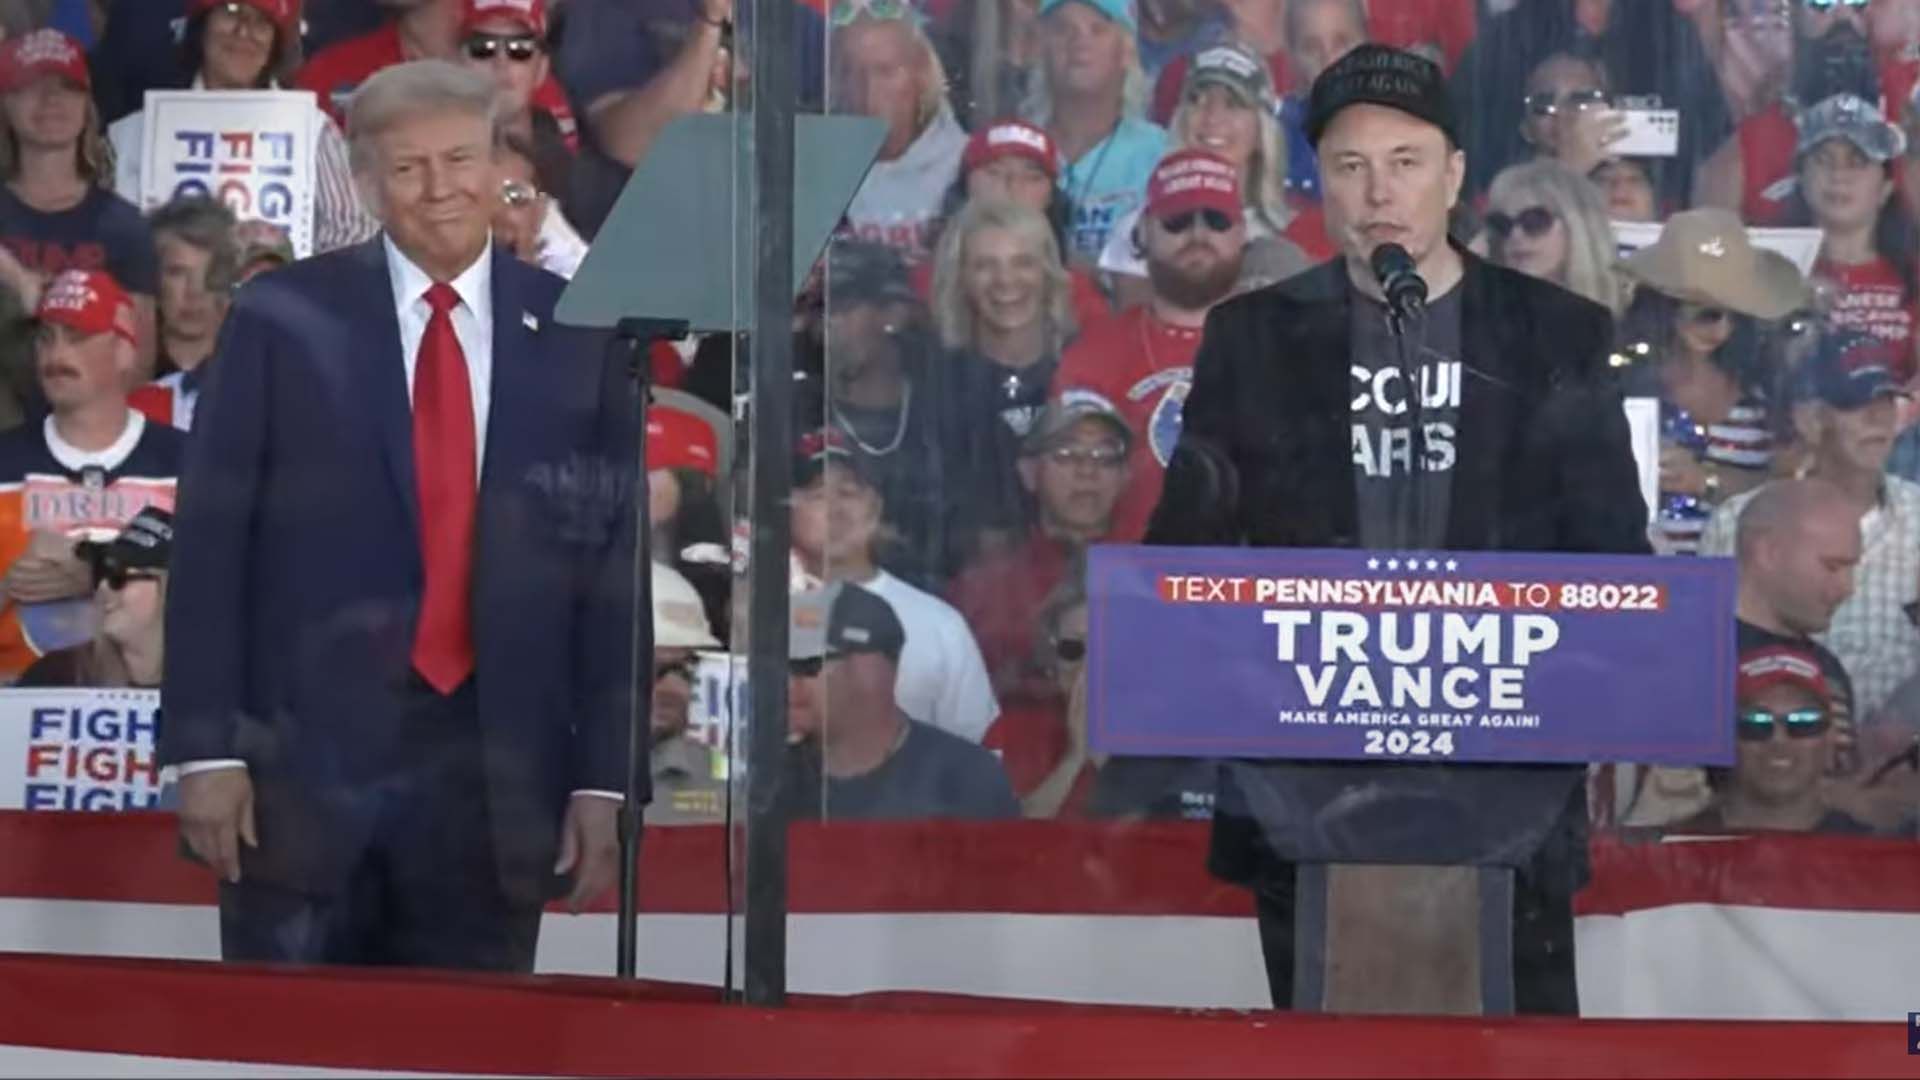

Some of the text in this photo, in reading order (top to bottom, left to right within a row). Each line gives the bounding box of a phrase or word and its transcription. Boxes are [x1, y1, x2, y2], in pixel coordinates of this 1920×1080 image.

[258, 132, 294, 236] FIG
[1166, 577, 1658, 609] TEXT PENNSYLVANIA TO 88022
[1262, 610, 1561, 666] TRUMP
[1294, 665, 1525, 709] VANCE
[1279, 711, 1541, 728] MAKE AMERICA GREAT AGAIN!
[1363, 730, 1455, 755] 2024
[26, 746, 159, 785] FIGH
